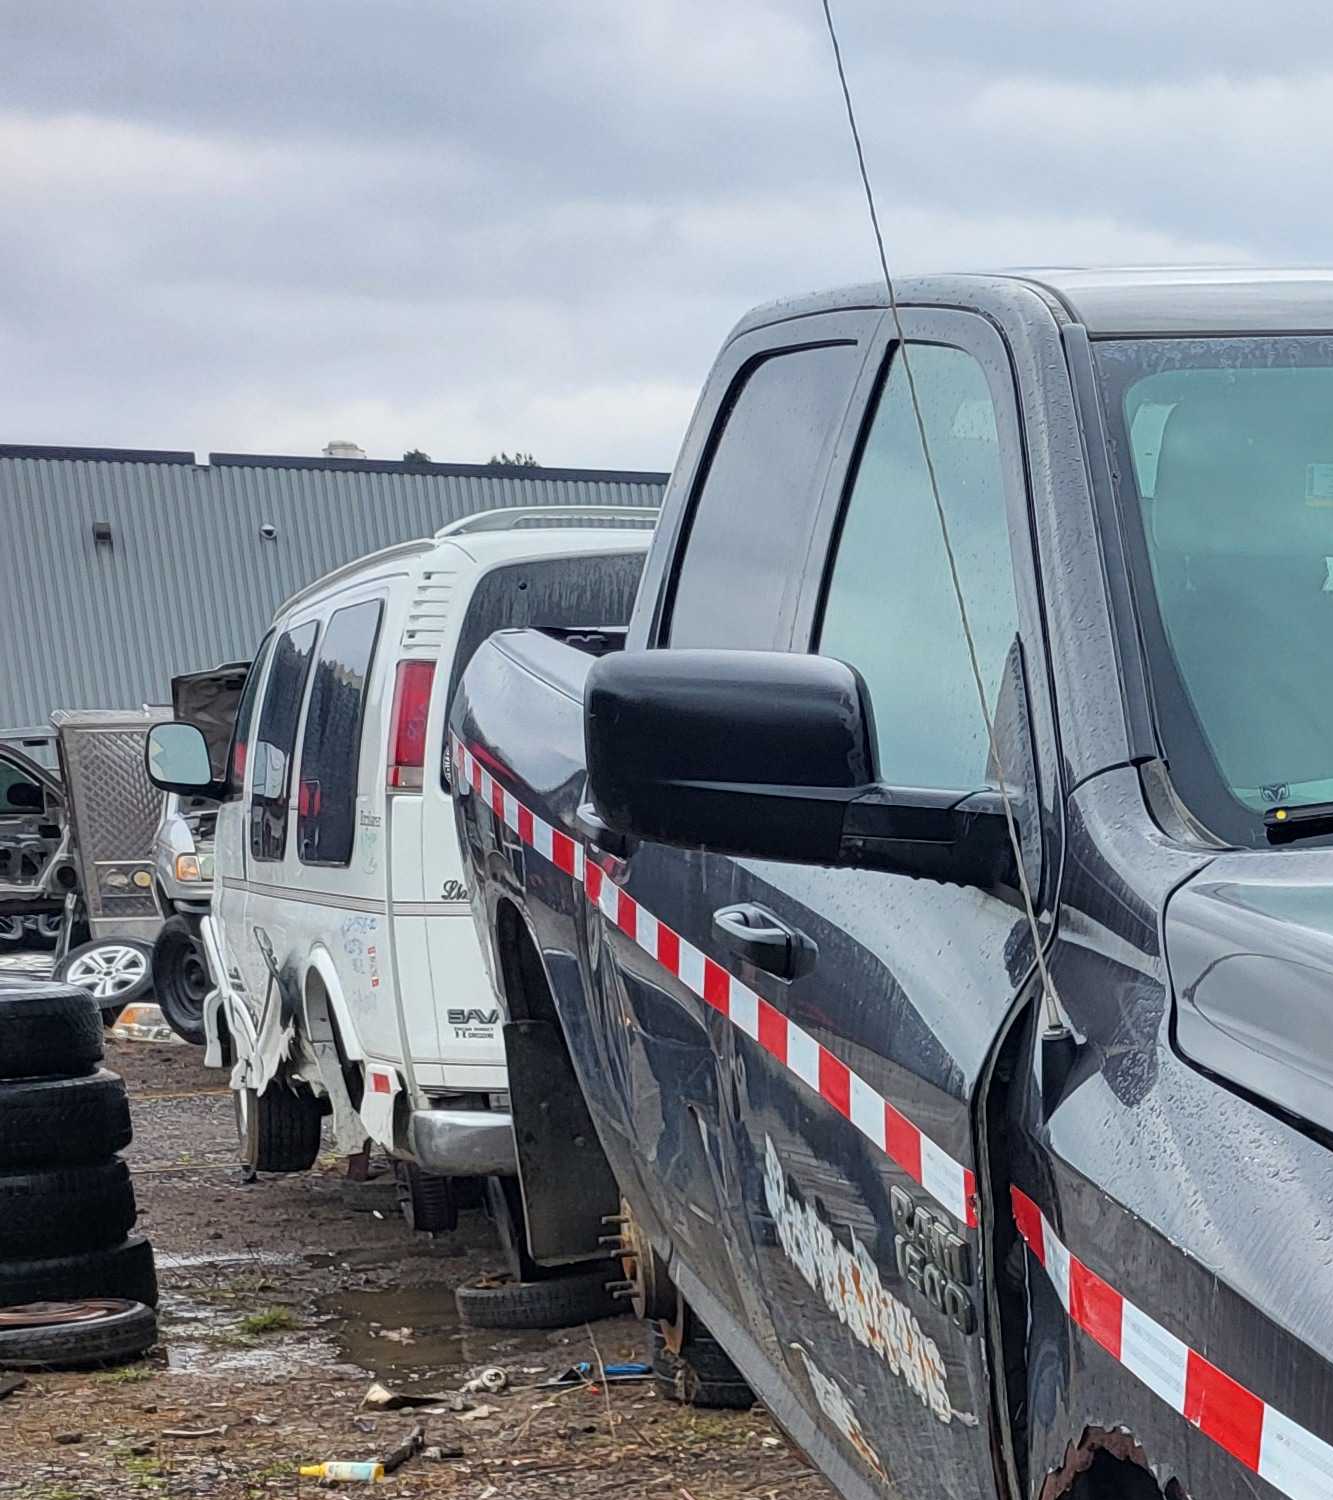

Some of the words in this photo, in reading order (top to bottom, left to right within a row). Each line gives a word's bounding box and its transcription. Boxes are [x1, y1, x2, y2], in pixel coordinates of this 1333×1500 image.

[447, 1008, 499, 1024] SAV
[891, 1185, 971, 1286] RAM
[895, 1234, 978, 1335] 1500
